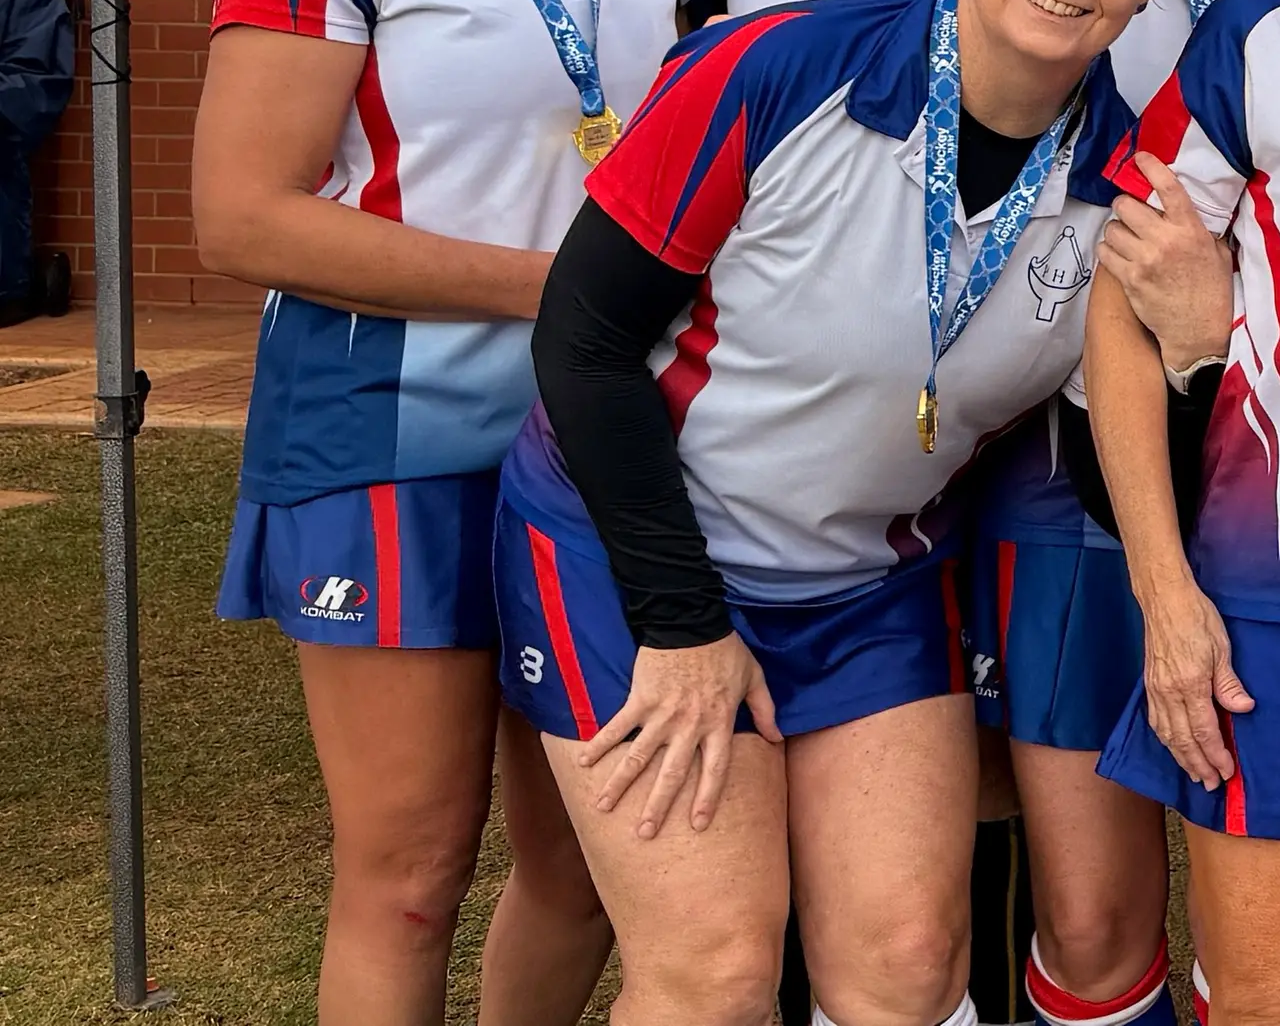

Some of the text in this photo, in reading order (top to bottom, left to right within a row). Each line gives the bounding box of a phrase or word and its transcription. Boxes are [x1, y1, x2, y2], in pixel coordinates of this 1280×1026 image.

[936, 10, 955, 56] Hockey
[933, 127, 951, 176] Hockey
[998, 196, 1029, 246] Hockey
[300, 605, 365, 623] KOMBAT
